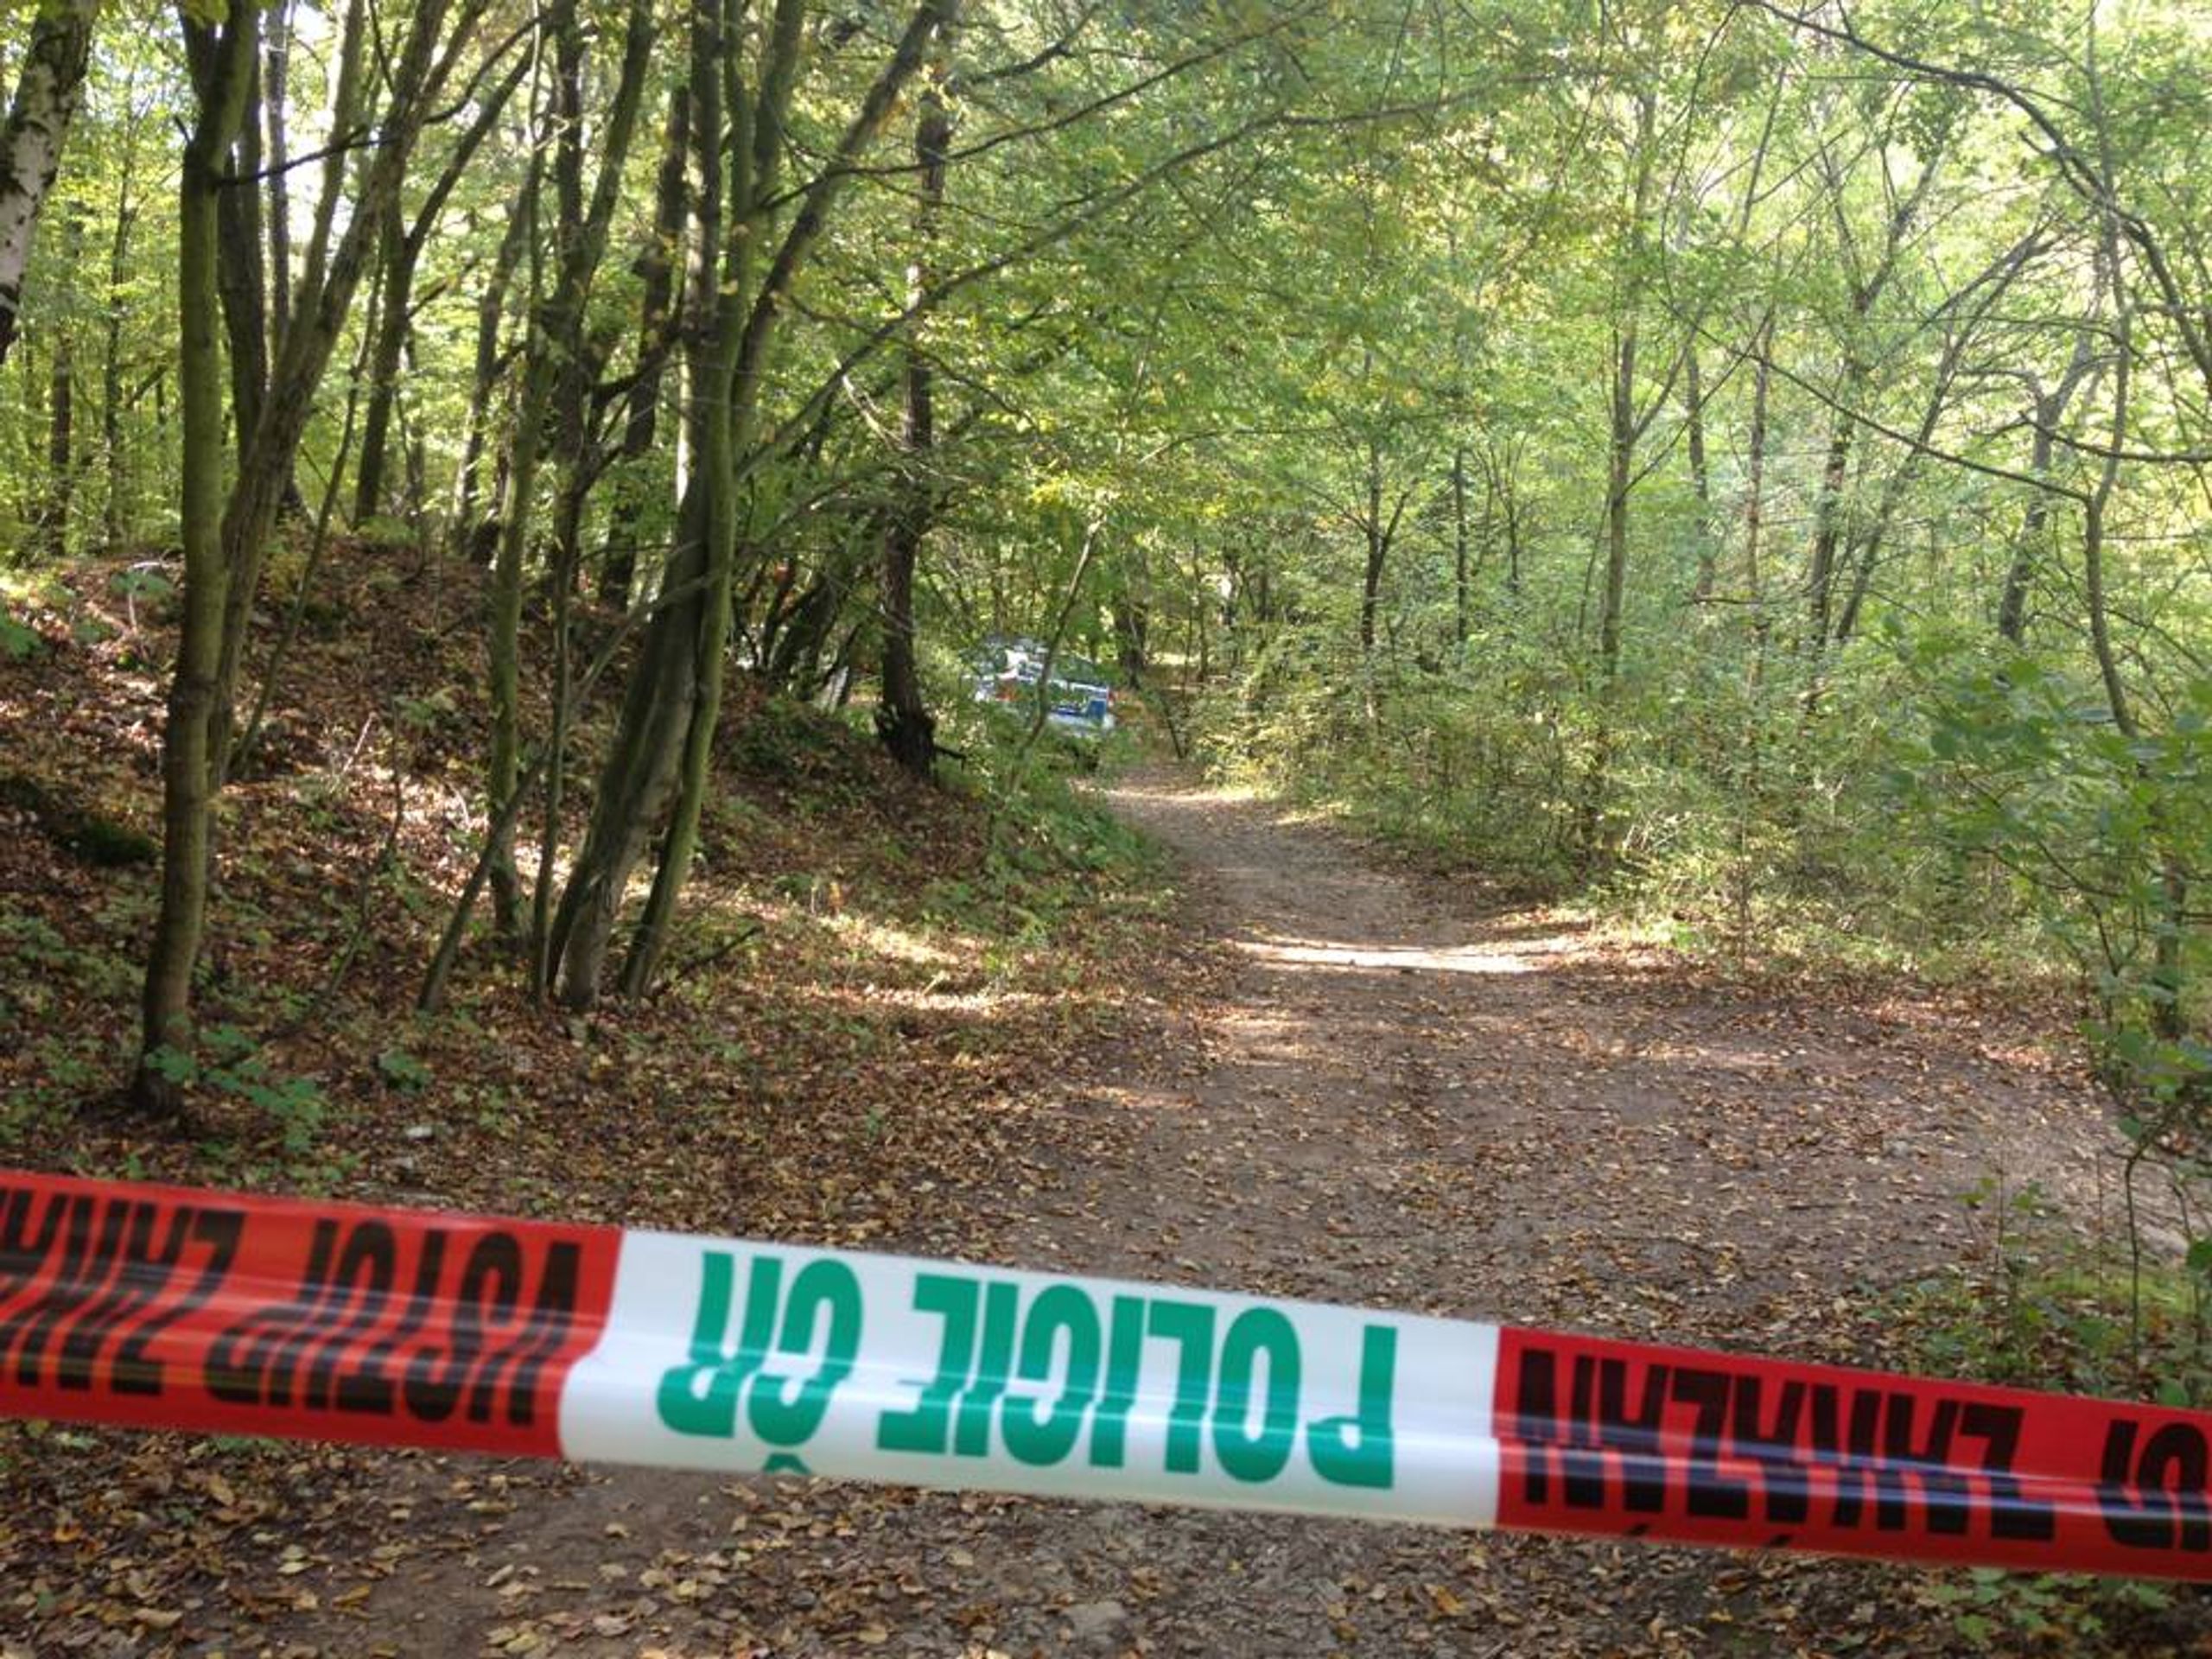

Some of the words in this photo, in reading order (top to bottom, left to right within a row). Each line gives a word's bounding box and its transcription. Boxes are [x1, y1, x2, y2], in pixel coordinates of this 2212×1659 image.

[202, 1217, 582, 1427] VSTUP
[656, 1249, 863, 1475] ČR
[876, 1272, 1397, 1490] POLICIE
[1516, 1348, 2056, 1548] ZAKÁZÁN
